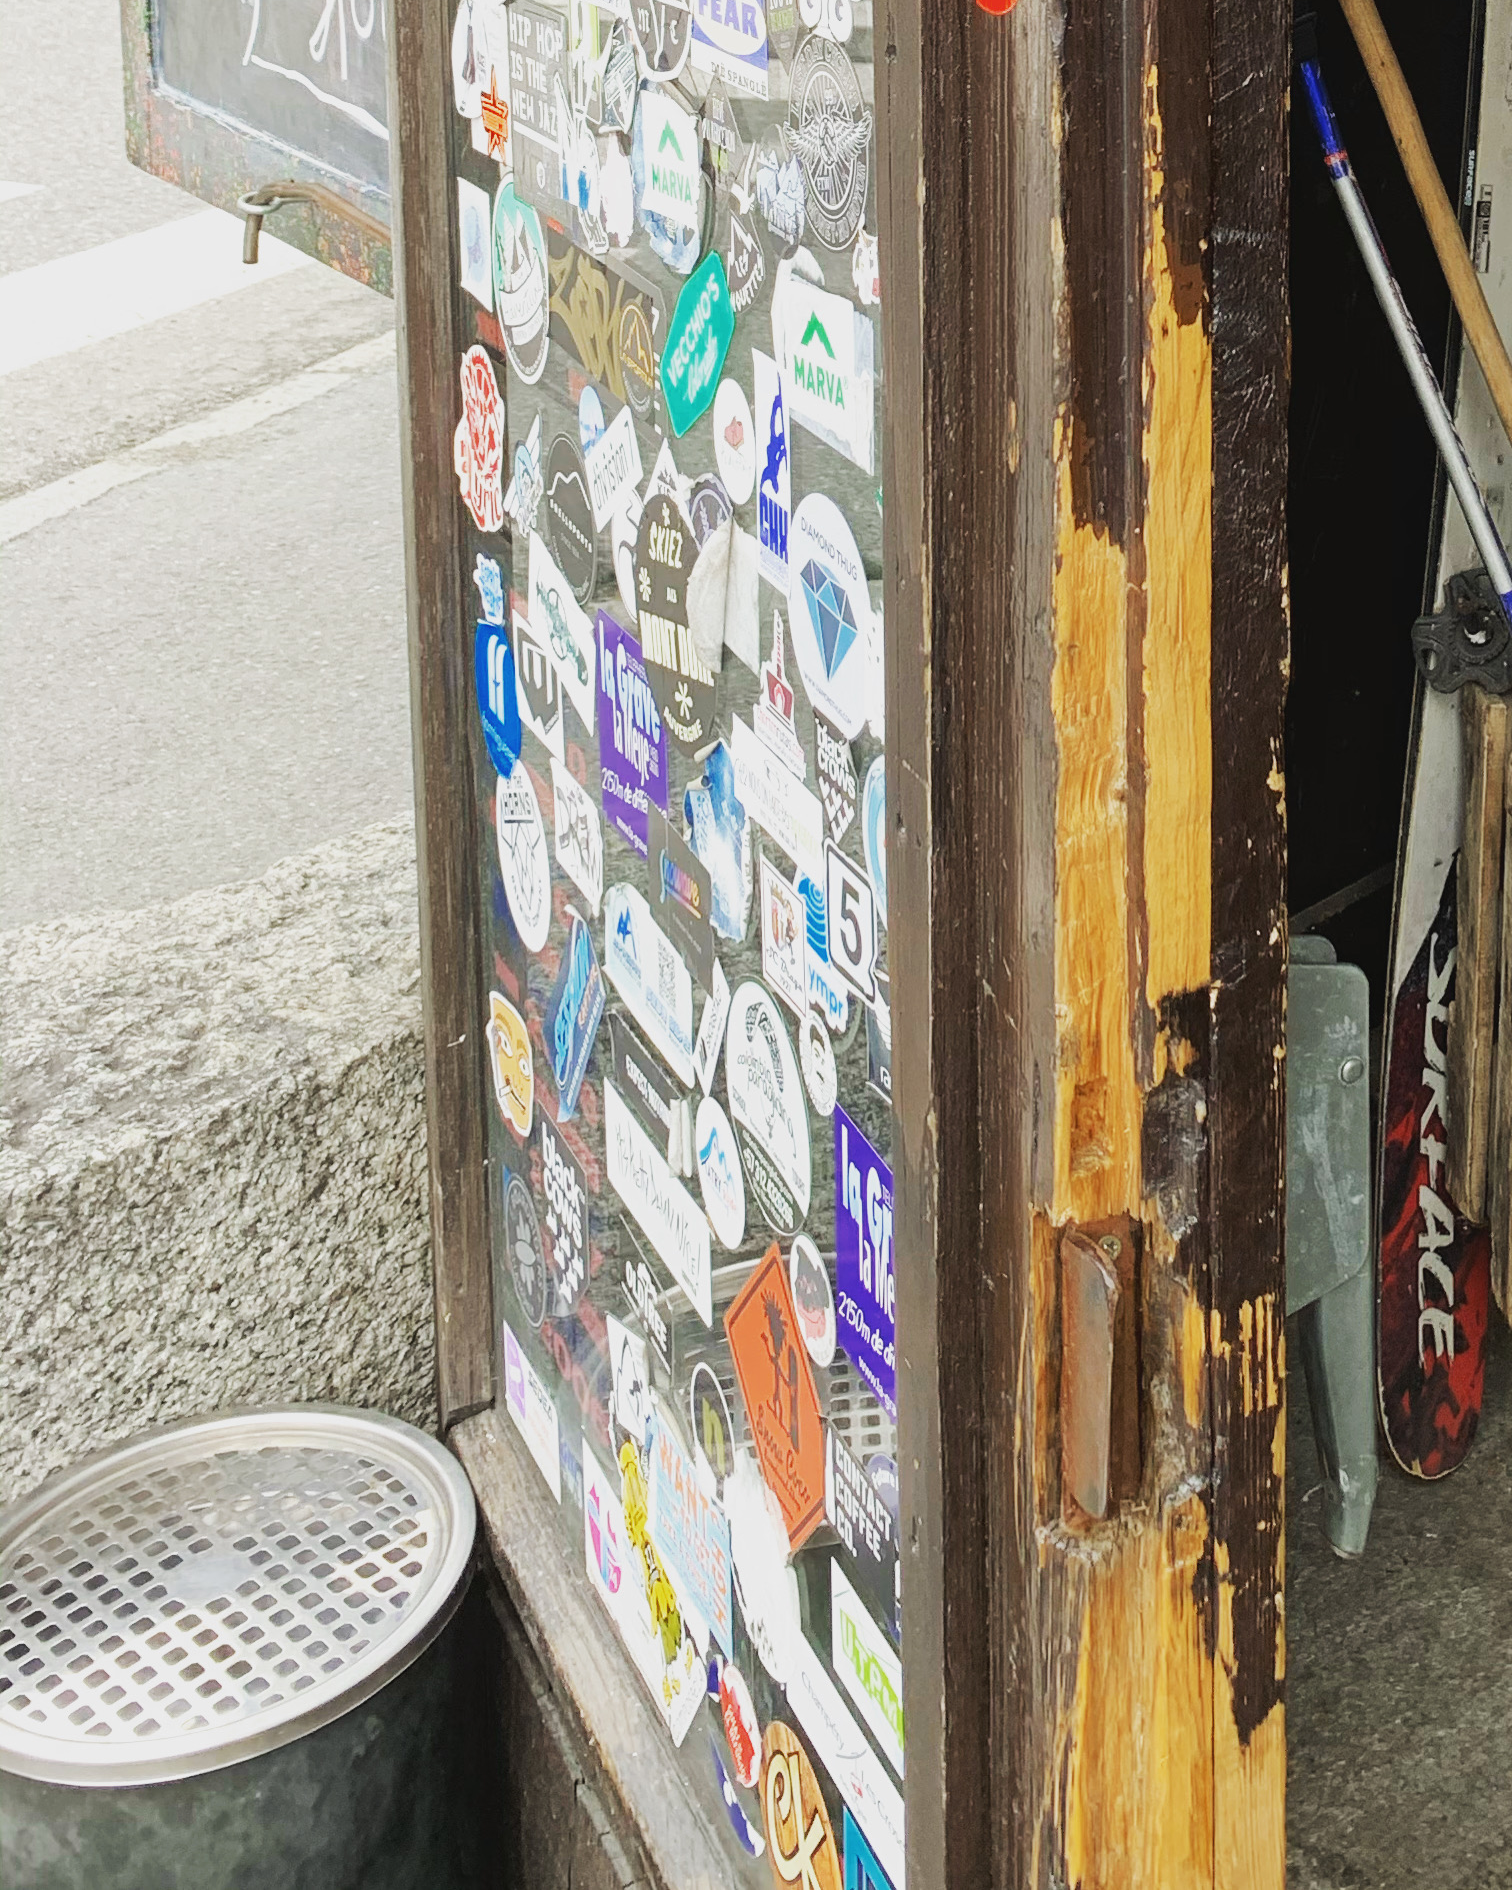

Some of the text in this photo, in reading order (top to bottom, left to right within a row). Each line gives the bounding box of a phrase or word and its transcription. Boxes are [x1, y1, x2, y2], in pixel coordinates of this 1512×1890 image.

[510, 16, 564, 63] HIP HOP
[510, 49, 547, 93] IS THE
[512, 87, 535, 117] NEW
[652, 163, 693, 205] MARVA
[668, 272, 720, 387] VECCHIO'S
[794, 354, 846, 410] MARVA
[649, 520, 683, 570] SKIEZ
[759, 491, 789, 565] CHX
[800, 516, 858, 581] DIAMOND THUG
[639, 611, 678, 673] MONT
[616, 641, 661, 745] Grave
[815, 716, 851, 773] black
[817, 747, 857, 801] crows
[840, 876, 863, 967] 5
[542, 1121, 585, 1217] black
[835, 1439, 892, 1542] CONTACT
[835, 1471, 882, 1563] COFFEE
[835, 1504, 858, 1558] CO.
